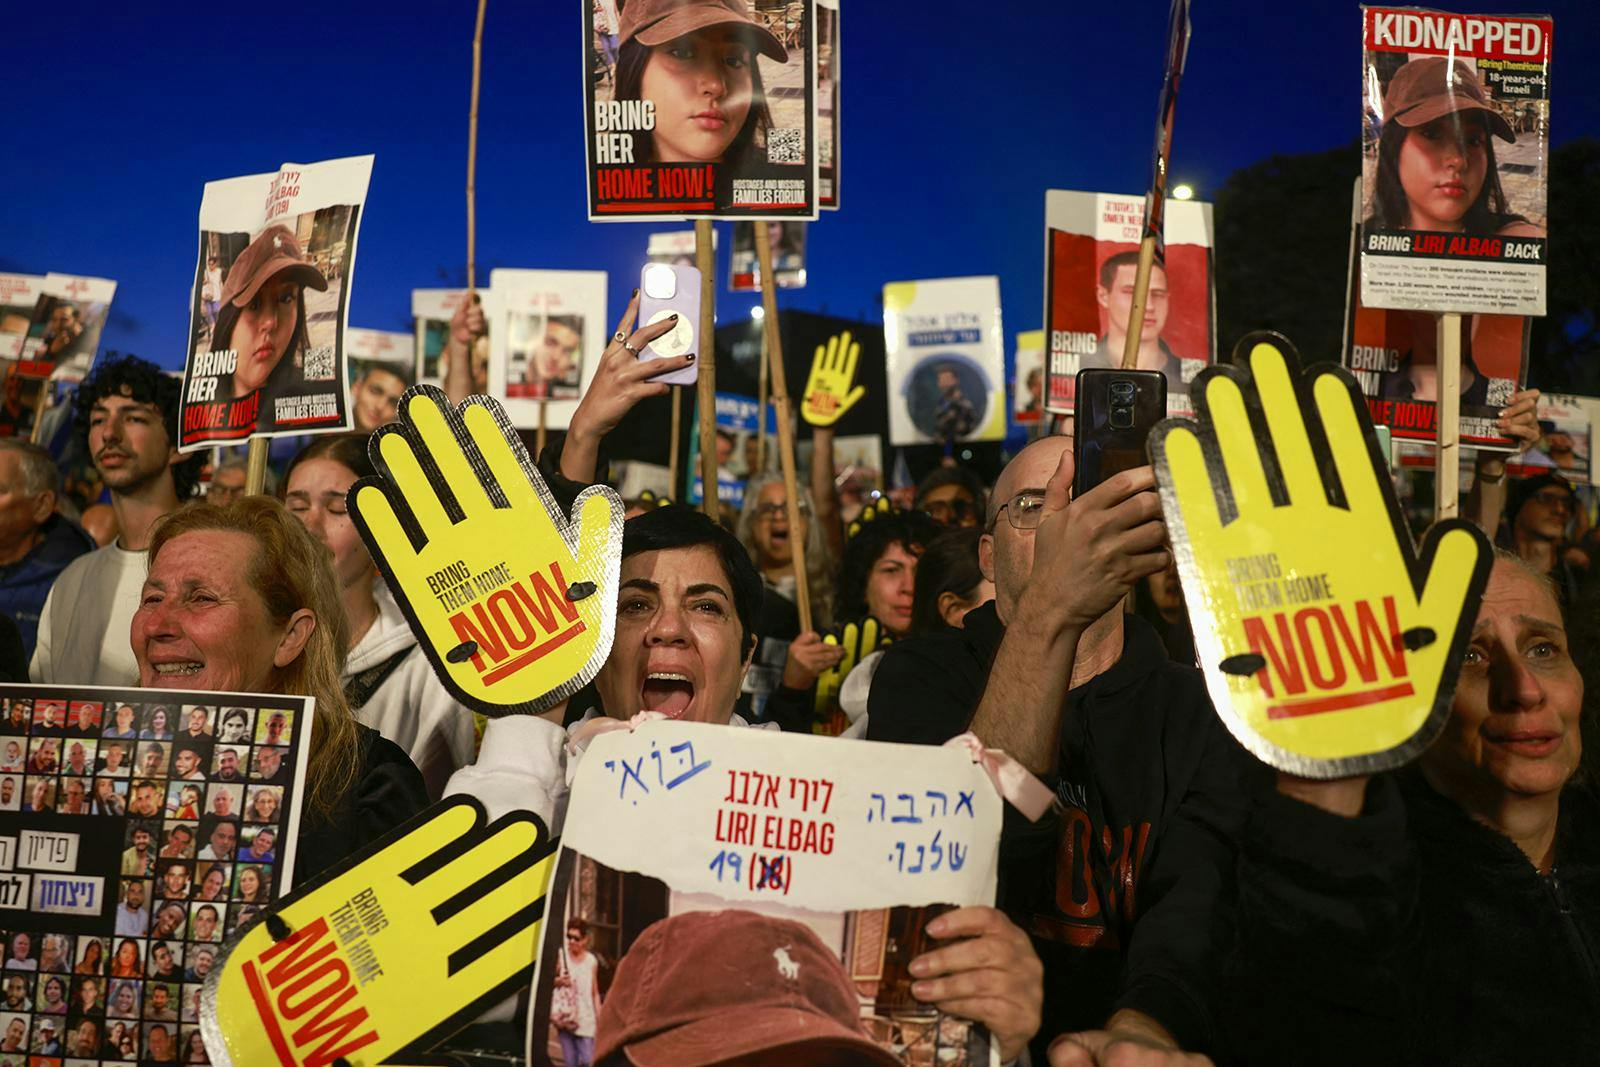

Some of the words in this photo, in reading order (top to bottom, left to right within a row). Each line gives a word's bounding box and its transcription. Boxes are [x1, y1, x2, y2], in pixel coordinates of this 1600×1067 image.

[1373, 12, 1542, 56] KIDNAPPED
[1503, 84, 1531, 96] Israeli
[594, 100, 656, 131] BRING
[596, 133, 635, 164] HER
[597, 168, 653, 200] HOME
[658, 165, 714, 199] NOW!
[733, 189, 773, 204] FAMILIES
[774, 189, 805, 204] FORUM
[1367, 234, 1411, 252] BRING
[1413, 233, 1447, 254] LIRI
[1448, 235, 1502, 258] ALBAG
[1504, 242, 1542, 260] BACK
[1052, 331, 1098, 354] BRING
[1352, 344, 1400, 373] BRING
[192, 349, 238, 377] BRING
[1051, 353, 1081, 376] HIM
[187, 376, 218, 403] HER
[185, 403, 227, 433] HOME
[275, 404, 309, 421] FAMILIES
[308, 402, 338, 419] FORUM
[426, 560, 471, 596] BRING
[436, 579, 478, 614] THEM
[472, 561, 514, 596] HOME
[1283, 573, 1335, 604] HOME
[448, 560, 580, 674] NOW
[1242, 595, 1409, 699] NOW
[724, 769, 781, 809] אלבג
[789, 777, 834, 814] לירי
[867, 790, 975, 824] אהבה
[715, 809, 758, 847] LIRI
[762, 815, 836, 856] ELBAG
[28, 835, 70, 865] פדיון
[709, 850, 743, 883] 19
[39, 879, 96, 910] ניצחון
[329, 900, 365, 947] THEM
[351, 886, 390, 937] BRING
[345, 938, 385, 988] HOME
[257, 915, 381, 1067] NOW
